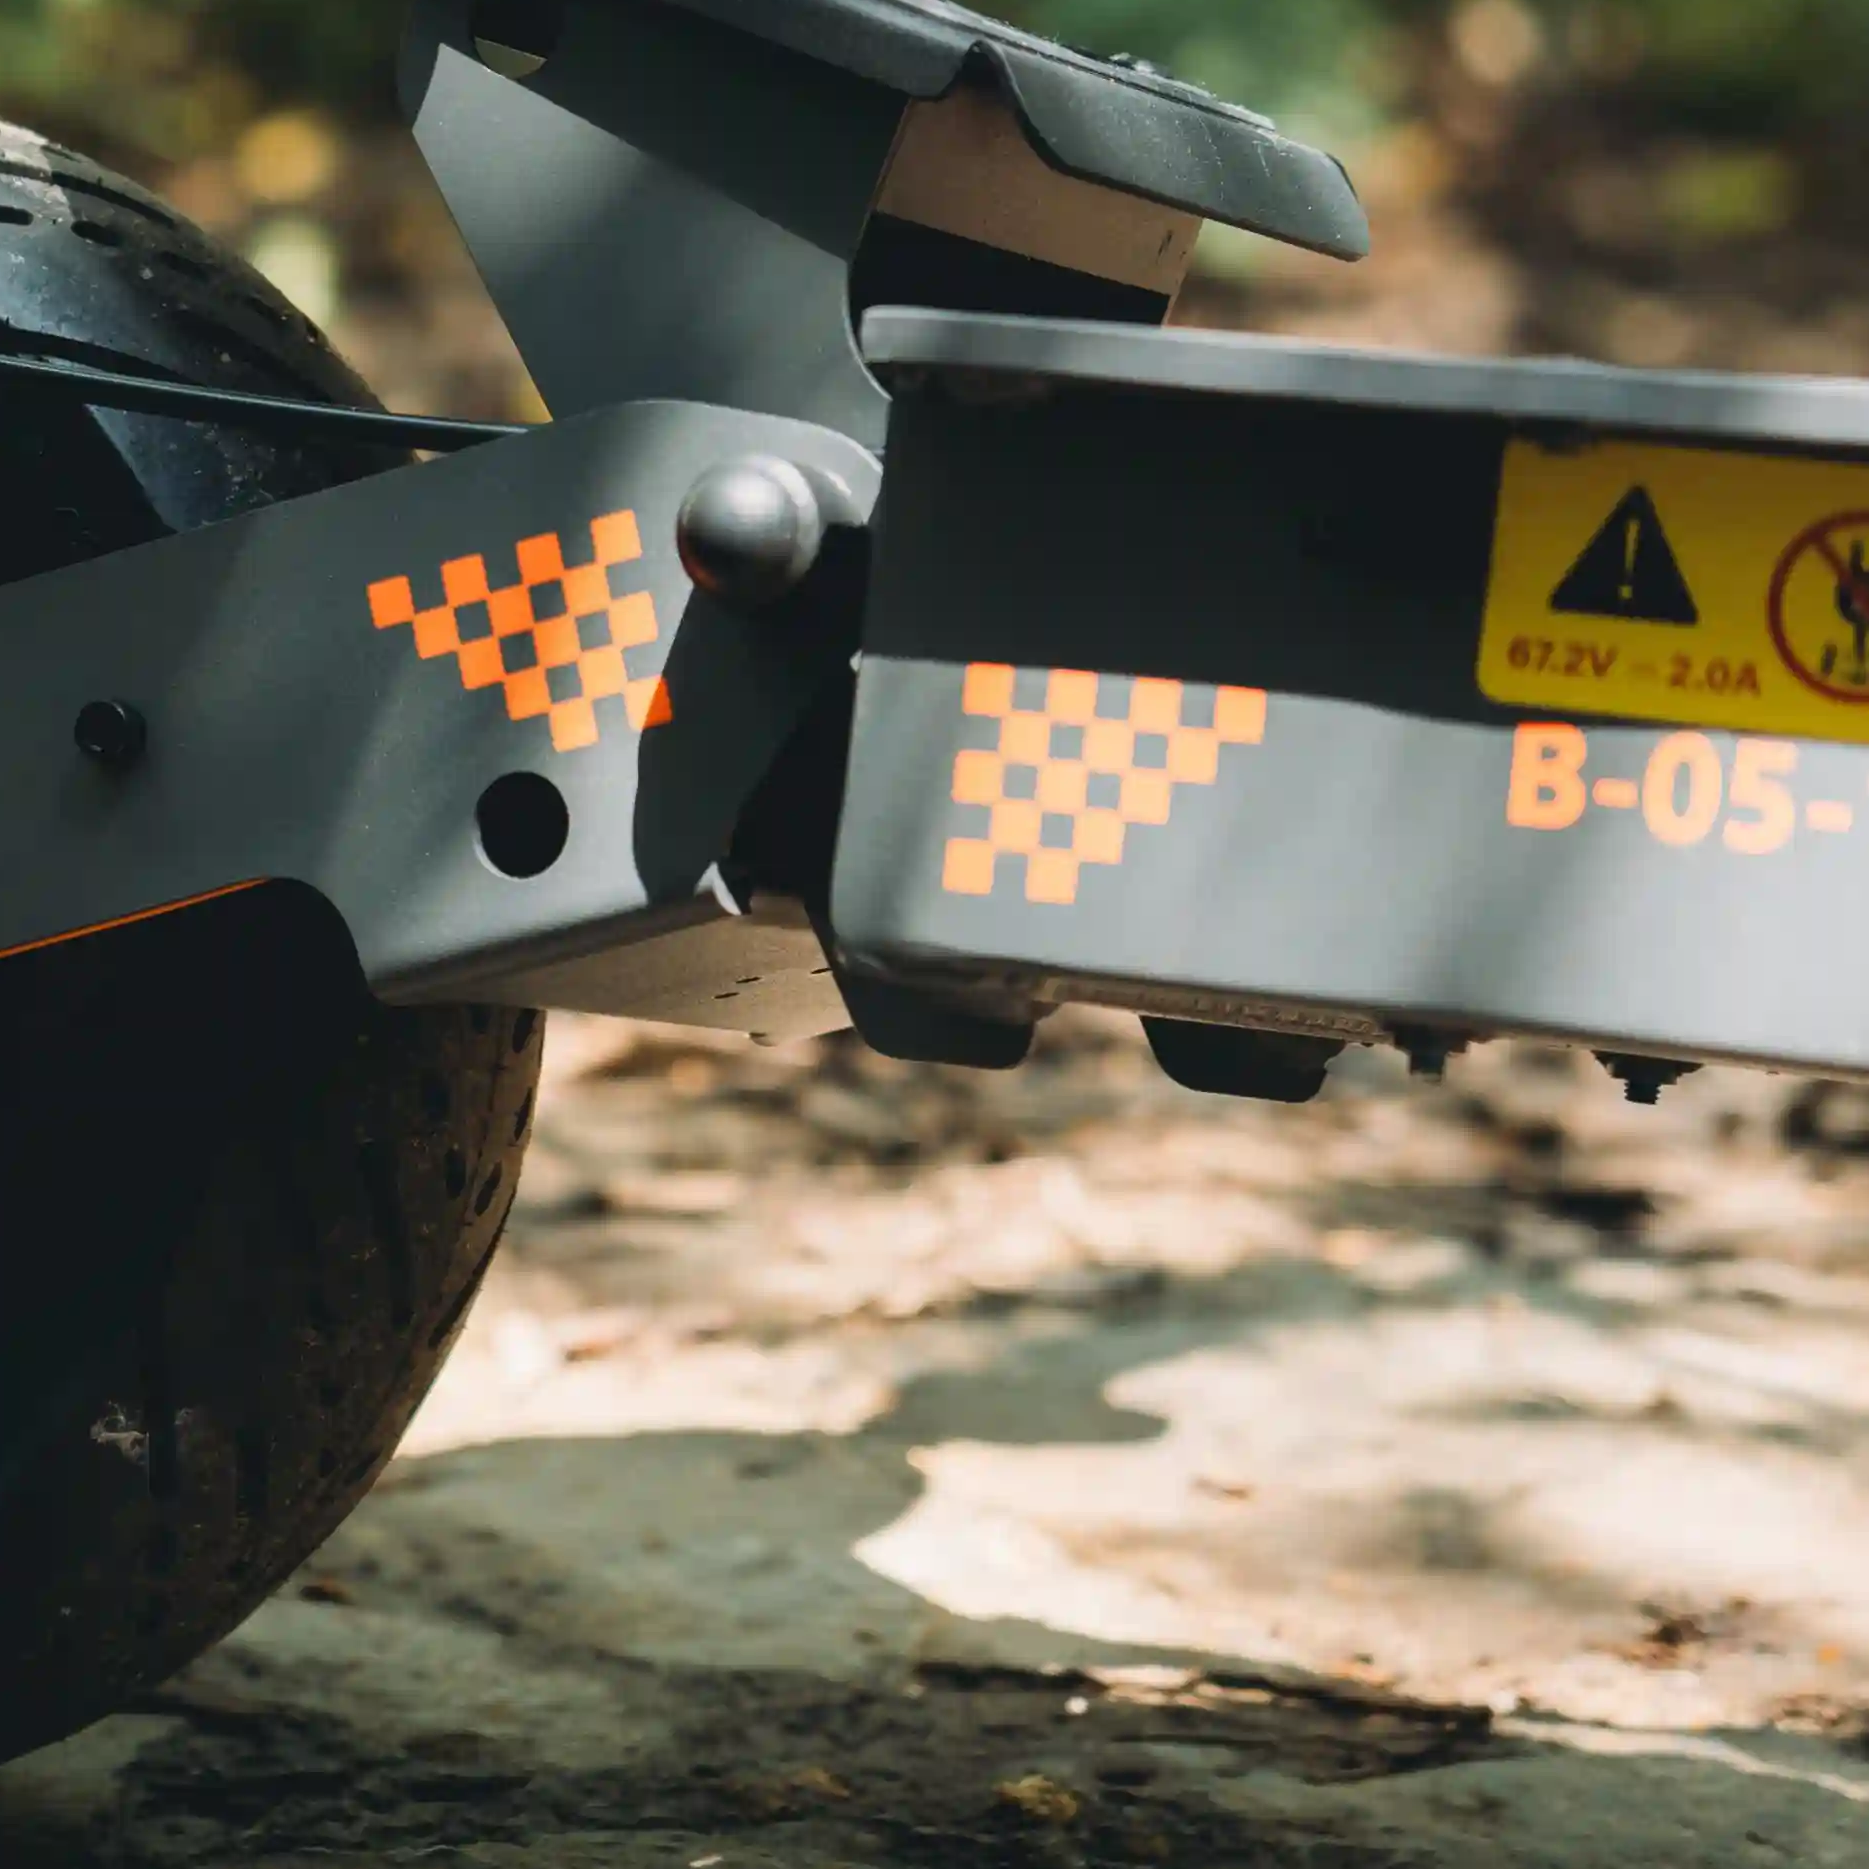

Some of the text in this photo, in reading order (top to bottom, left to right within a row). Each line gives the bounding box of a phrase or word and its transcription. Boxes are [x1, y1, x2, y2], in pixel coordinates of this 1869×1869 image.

[1507, 635, 1762, 698] 67.2V 2.0A
[1506, 721, 1869, 855] B-05-
